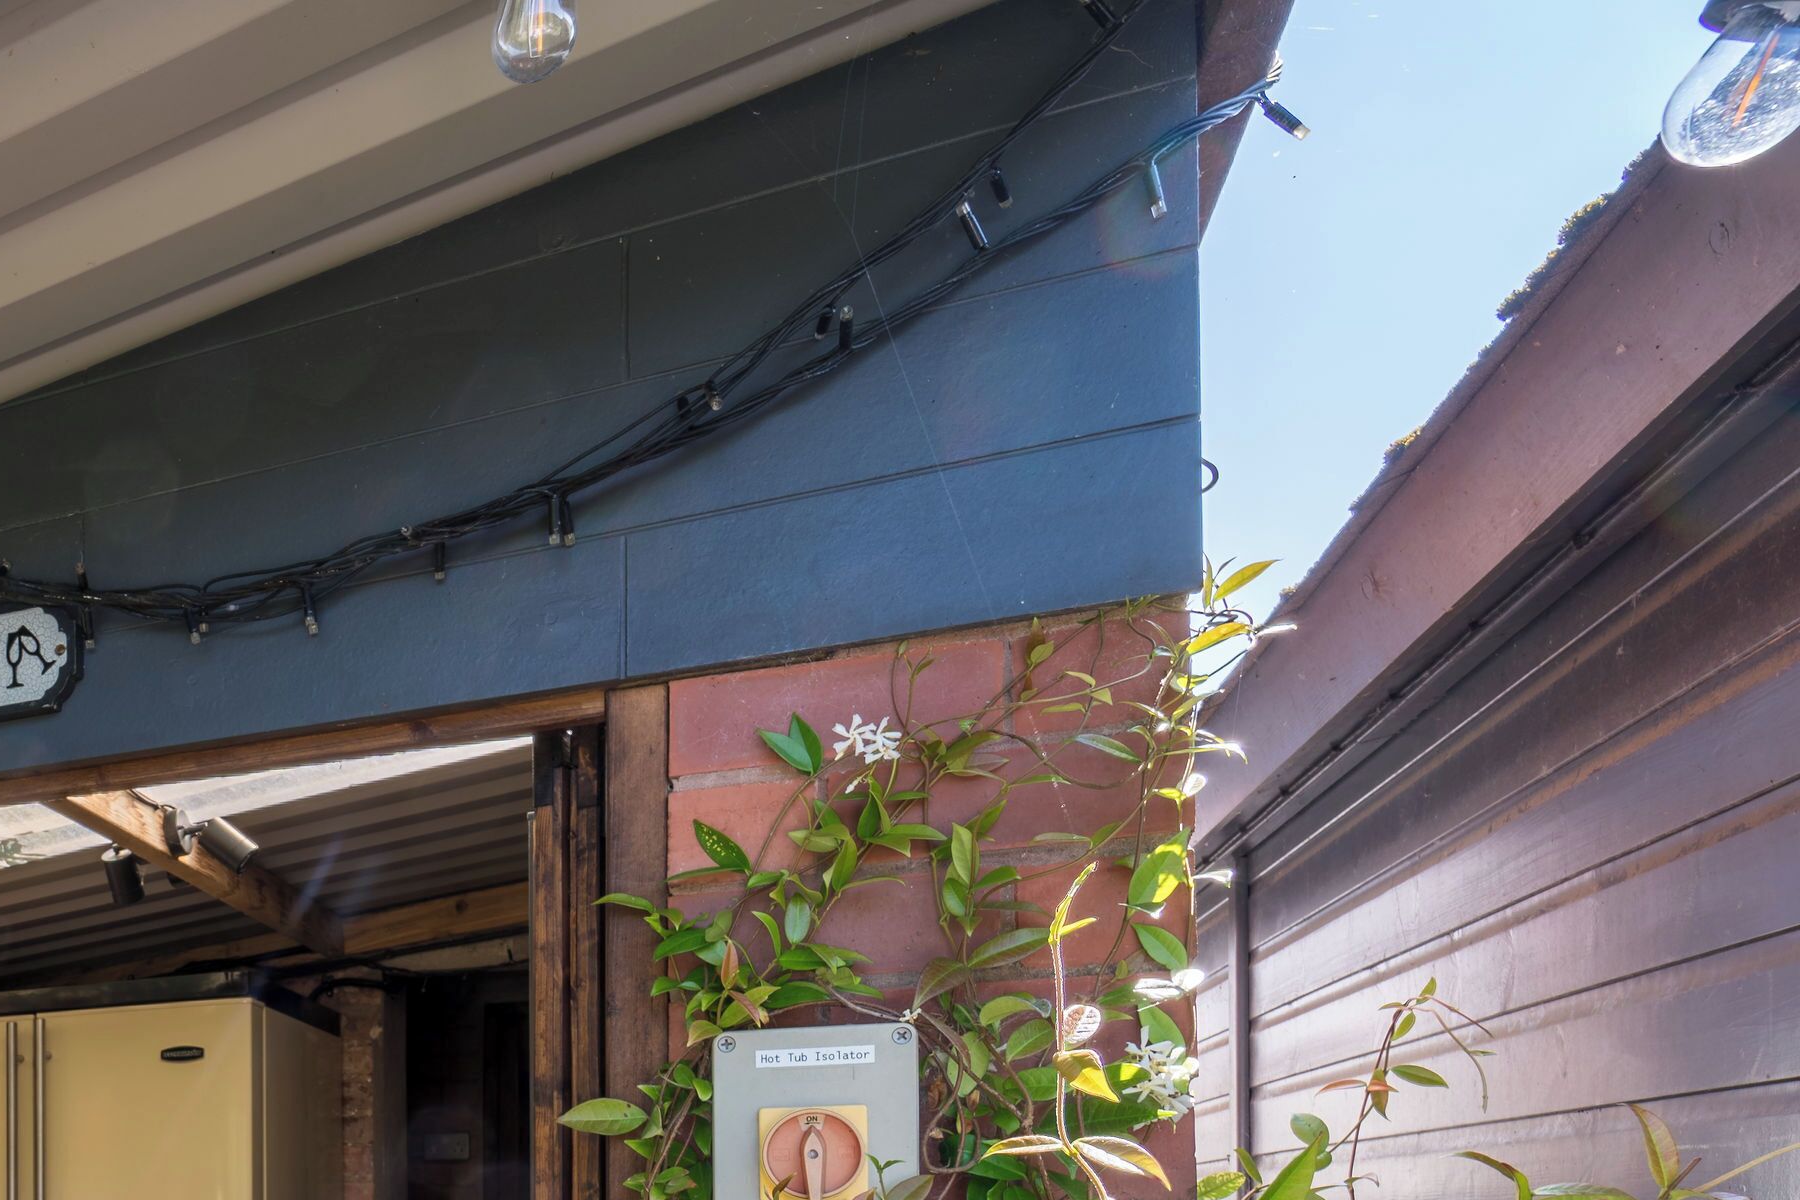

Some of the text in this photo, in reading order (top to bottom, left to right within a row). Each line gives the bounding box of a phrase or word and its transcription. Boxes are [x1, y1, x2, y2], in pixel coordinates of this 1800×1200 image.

[760, 1050, 871, 1064] Hot Tub Isolator
